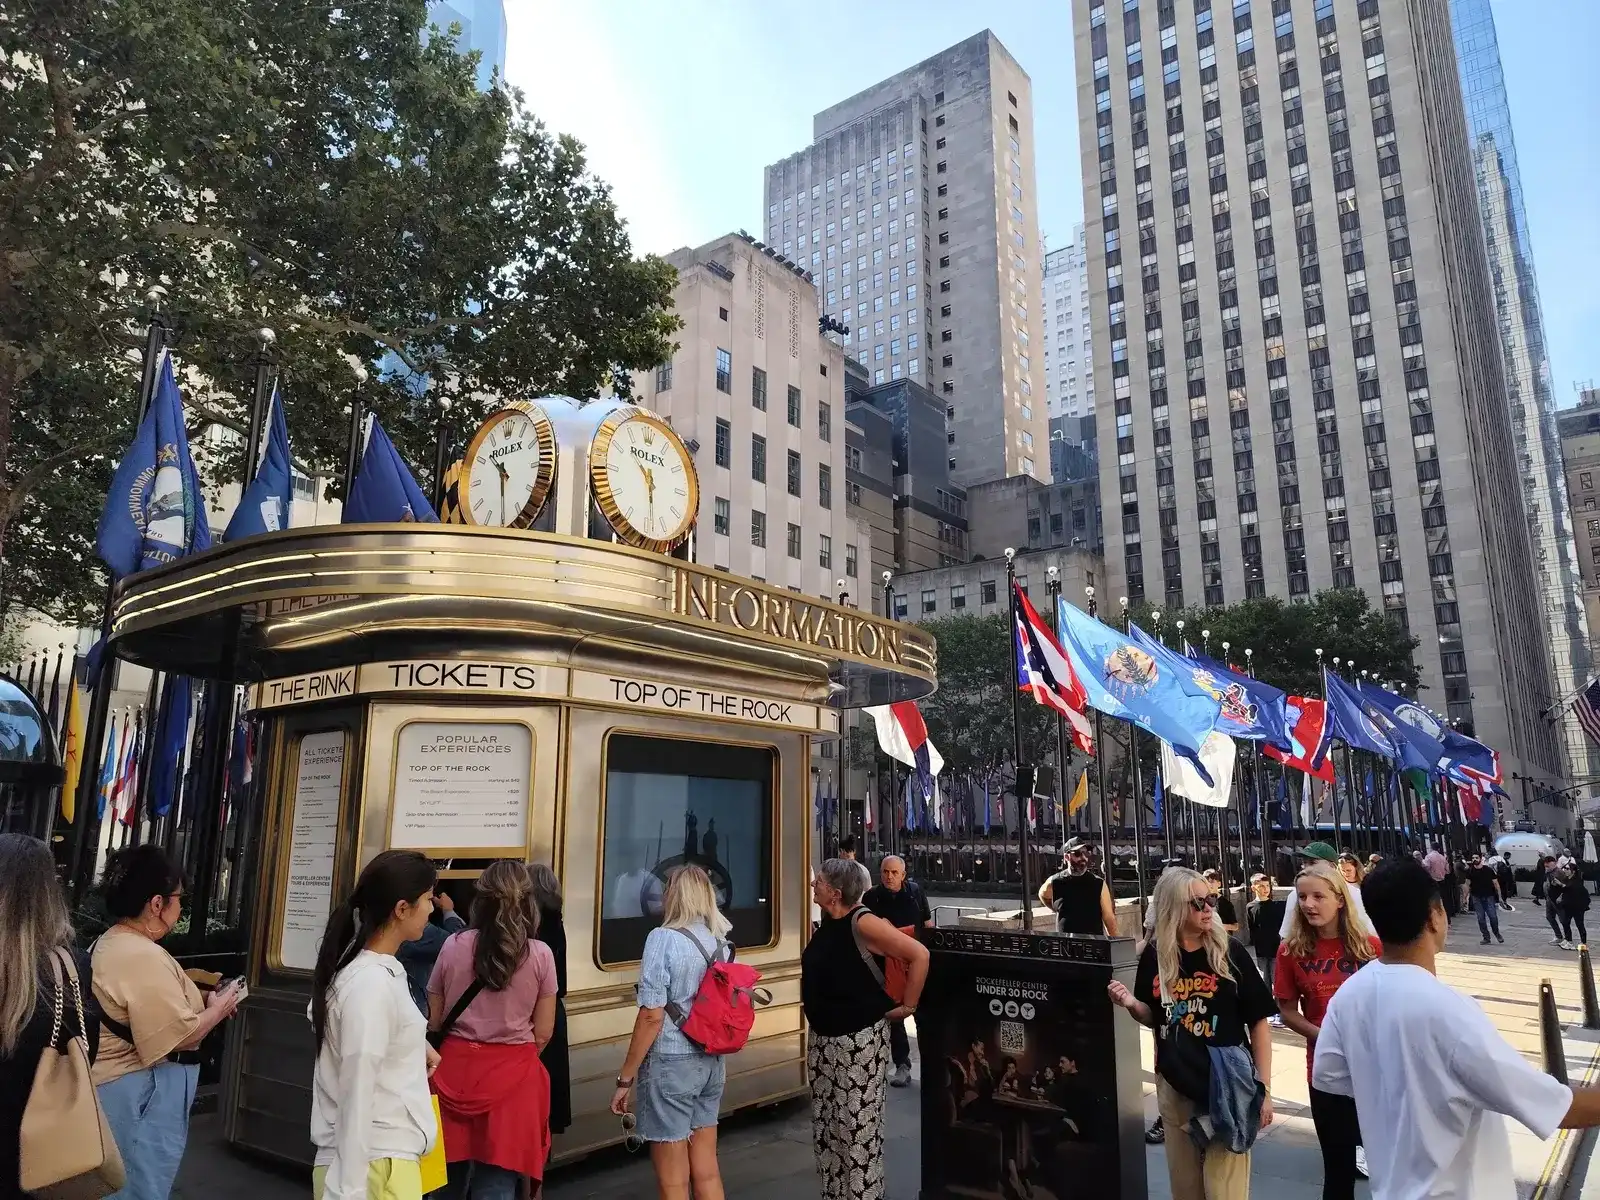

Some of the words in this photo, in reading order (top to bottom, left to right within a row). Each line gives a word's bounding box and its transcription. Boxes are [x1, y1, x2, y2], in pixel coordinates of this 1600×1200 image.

[492, 441, 523, 458] ROLEX
[630, 446, 665, 467] ROLEX
[671, 568, 901, 664] INFORMATION
[388, 663, 535, 690] TICKETS
[270, 679, 305, 704] THE
[309, 671, 352, 696] RINK
[610, 678, 657, 704] TOP
[662, 687, 692, 708] OF
[696, 692, 737, 716] THE
[741, 698, 792, 723] ROCK
[420, 745, 512, 753] EXPERIENCES
[436, 735, 498, 744] POPULAR
[976, 976, 1020, 988] ROCKEFELLER
[1022, 981, 1048, 991] CENTER
[976, 985, 1007, 996] UNDER
[1008, 988, 1020, 998] 30
[1022, 989, 1048, 1001] ROCK
[1152, 971, 1219, 1000] spect
